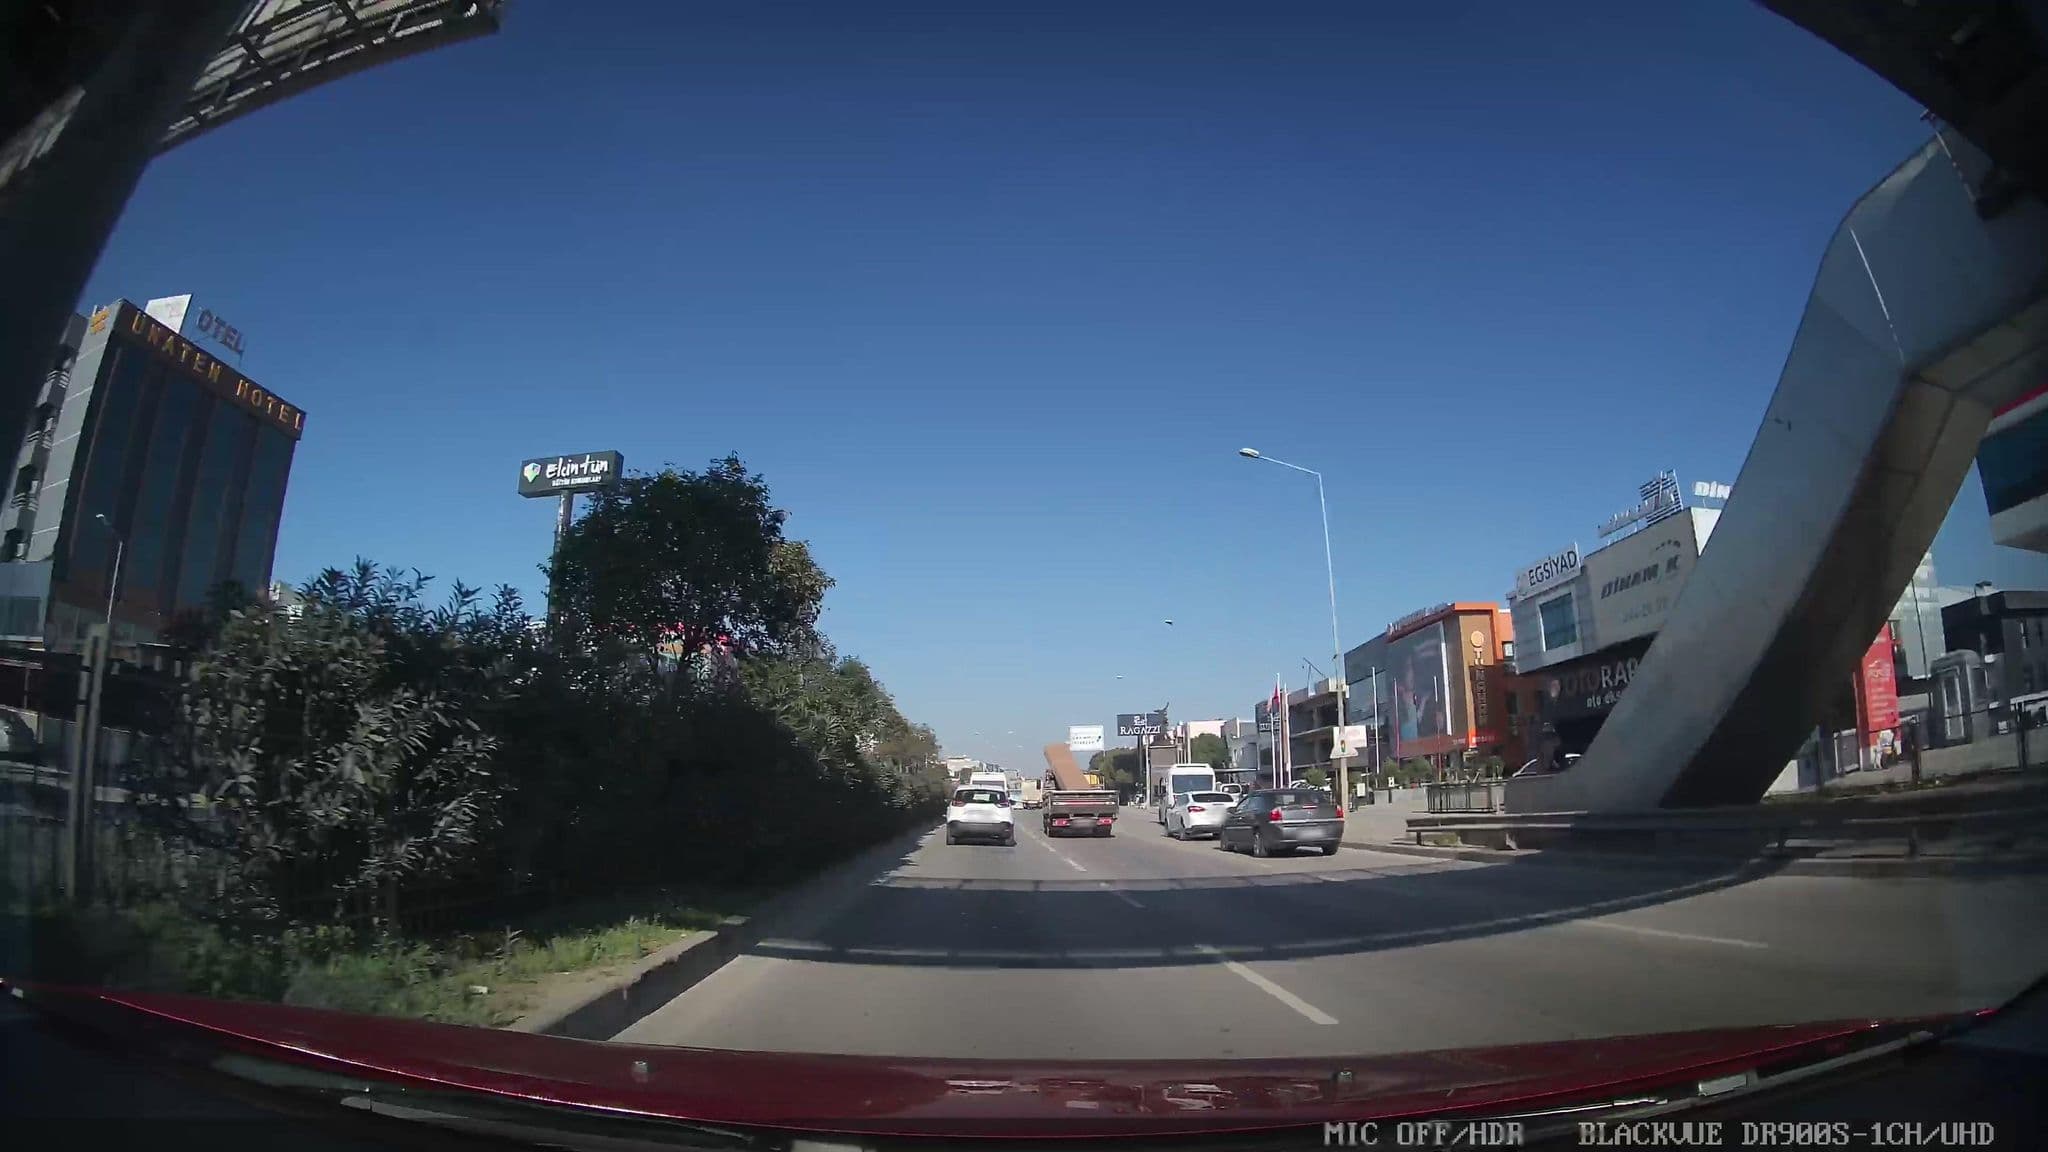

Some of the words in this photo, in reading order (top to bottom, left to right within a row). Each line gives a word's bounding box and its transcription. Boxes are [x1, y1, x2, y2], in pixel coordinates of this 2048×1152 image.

[197, 308, 246, 353] OTEL
[235, 379, 303, 431] HOTEL
[1528, 549, 1577, 587] EGSİYAD
[1120, 725, 1161, 736] RAGAZZI
